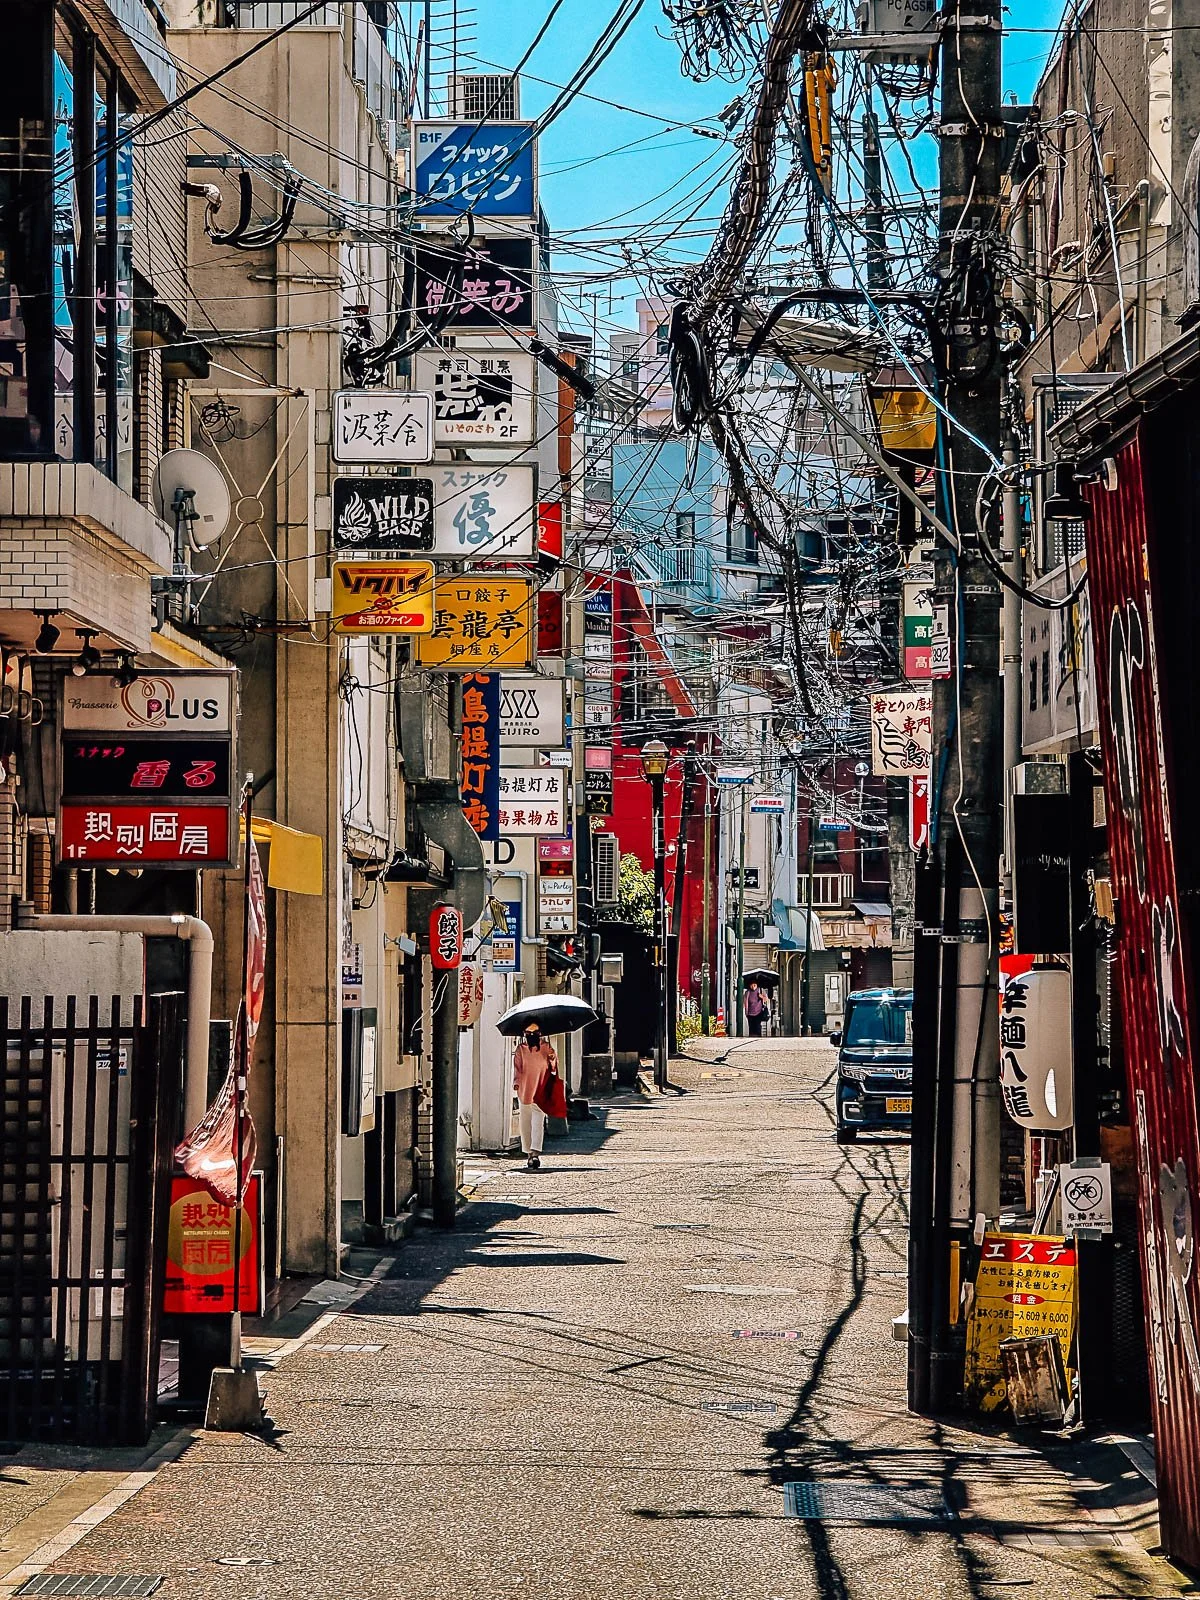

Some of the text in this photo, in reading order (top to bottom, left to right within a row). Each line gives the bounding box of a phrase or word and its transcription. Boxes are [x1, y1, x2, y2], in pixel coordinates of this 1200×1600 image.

[420, 133, 442, 143] B1F
[442, 145, 509, 162] スナック
[428, 169, 522, 201] ロビン
[438, 360, 511, 373] 寿司 割烹
[499, 425, 518, 437] 2F
[442, 471, 508, 488] スナック
[369, 495, 430, 522] WILD
[453, 491, 496, 545] 優
[378, 519, 423, 538] BASE
[502, 535, 518, 547] 1F
[437, 588, 510, 602] 一口餃子
[358, 615, 413, 625] お酒のファイン
[431, 609, 524, 639] 雲龍亭
[915, 656, 934, 668] 高
[68, 699, 219, 719] Brasserie PLUS
[900, 716, 932, 737] 専門
[74, 747, 125, 758] スナック
[130, 760, 217, 788] 香る
[66, 843, 87, 858] 1F
[438, 912, 458, 961] 餃子
[985, 1243, 1067, 1263] エステ
[1012, 1295, 1037, 1305] 料金
[1049, 1313, 1069, 1323] 6,000
